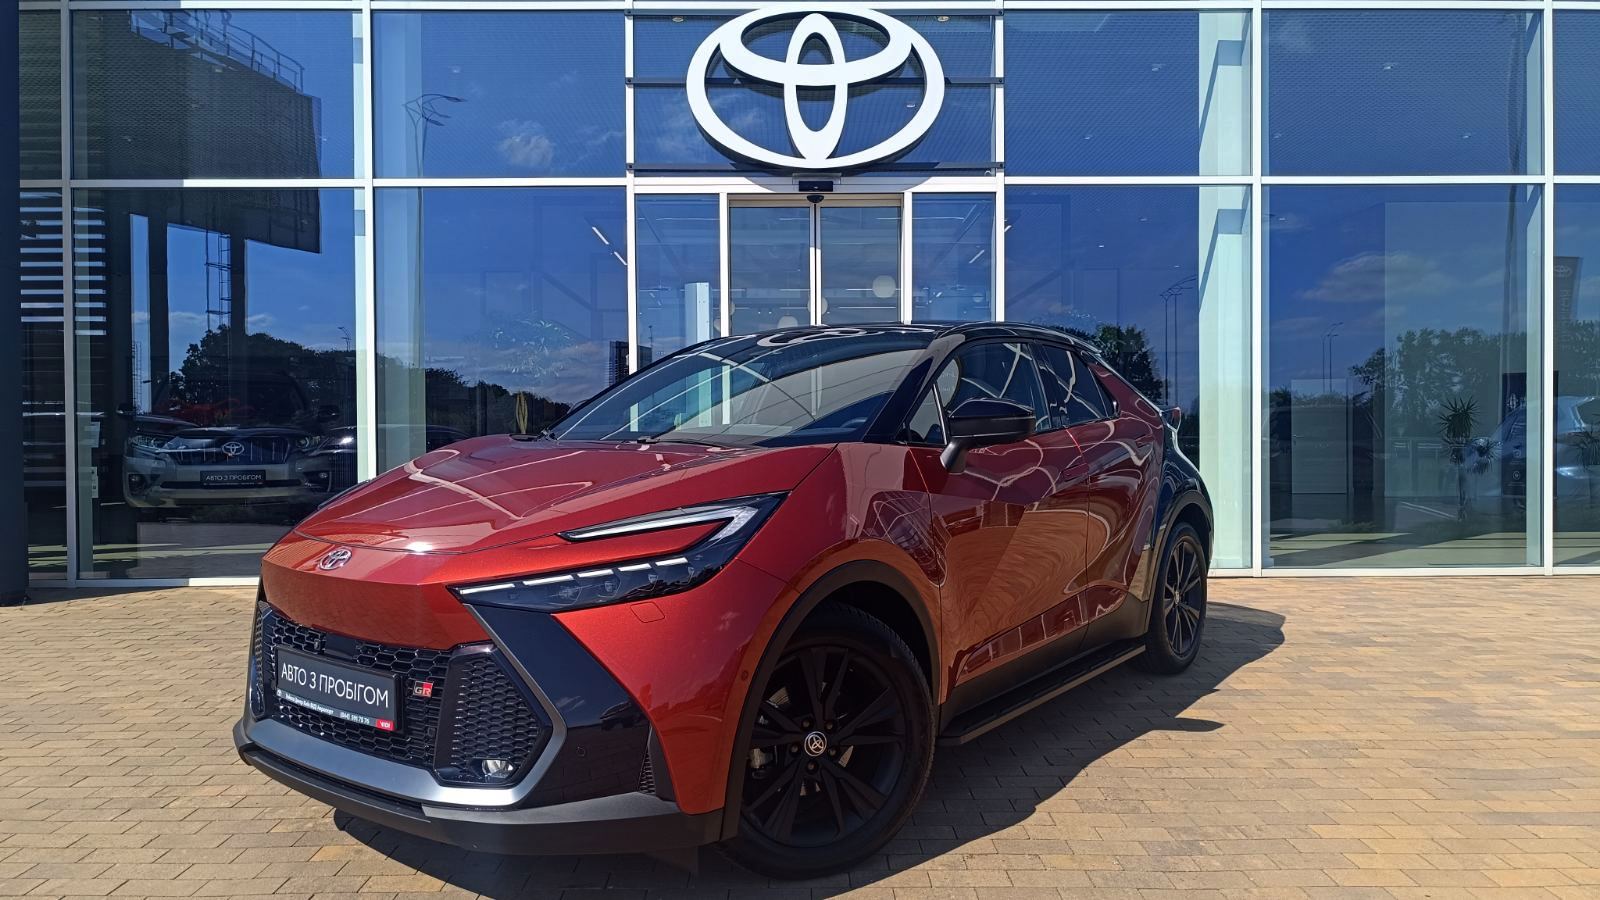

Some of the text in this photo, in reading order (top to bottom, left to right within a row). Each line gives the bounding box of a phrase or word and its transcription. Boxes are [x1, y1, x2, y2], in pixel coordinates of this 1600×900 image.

[281, 663, 307, 686] АВТО
[309, 672, 317, 689] З
[319, 674, 389, 708] ПРОБІГОМ
